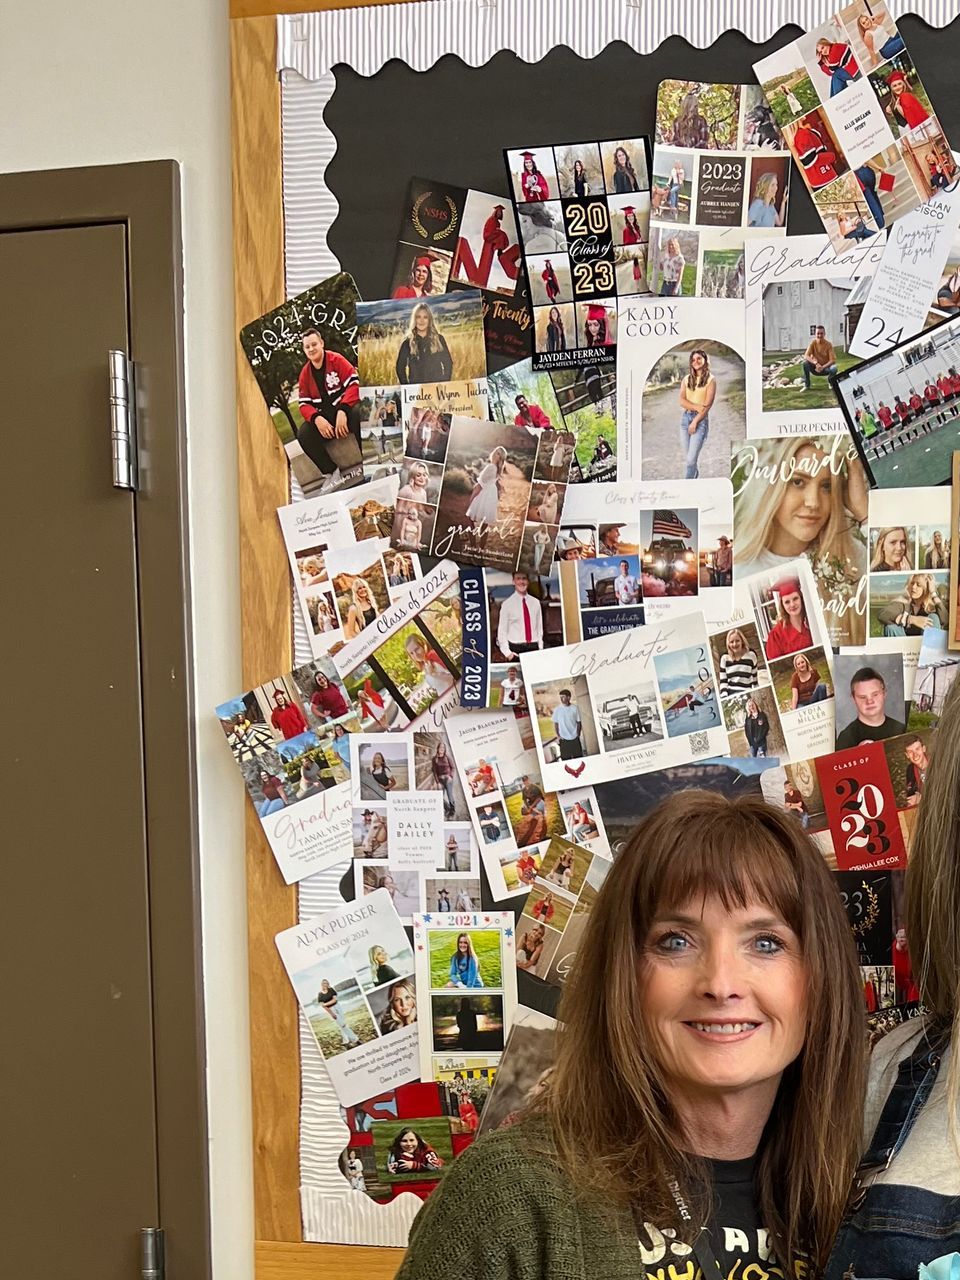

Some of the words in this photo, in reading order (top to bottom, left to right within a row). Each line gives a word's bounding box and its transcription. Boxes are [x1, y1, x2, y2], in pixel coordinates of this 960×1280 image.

[702, 163, 742, 180] 2023
[701, 181, 742, 194] Graduate
[424, 207, 448, 220] NSHS
[566, 202, 609, 236] 20
[923, 200, 951, 214] LIAN
[568, 236, 599, 263] Class
[747, 234, 887, 287] Graduate
[573, 260, 614, 294] 23
[492, 300, 530, 331] Twenty
[627, 305, 678, 322] KADY
[254, 304, 302, 362] 2024
[626, 322, 680, 337] COOK
[864, 316, 905, 347] 24
[539, 352, 571, 363] JAYDEN
[572, 348, 606, 359] FERRAN
[404, 388, 432, 403] Loralee
[436, 385, 460, 402] Wynn
[777, 423, 808, 434] TYLER
[731, 434, 844, 498] Onward
[435, 512, 521, 557] graduate
[376, 607, 408, 634] Class
[408, 590, 421, 610] of
[418, 570, 449, 600] 2024
[462, 578, 482, 633] CLASS
[587, 627, 599, 635] THE
[464, 638, 485, 660] of
[569, 629, 674, 686] Graduate
[464, 665, 482, 701] 2023
[798, 711, 826, 724] MILLER
[799, 706, 822, 718] LYDIA
[458, 726, 477, 737] JACOB
[478, 717, 508, 733] BLACKHAM
[833, 761, 858, 771] CLASS
[859, 757, 870, 765] OF
[835, 778, 884, 820] 20
[274, 792, 352, 849] Gradua
[840, 813, 890, 855] 23
[298, 824, 340, 848] TANALYN
[874, 859, 886, 867] LEE
[886, 856, 899, 865] COX
[296, 924, 328, 948] ALYX
[328, 904, 377, 935] PURSER
[316, 940, 339, 956] CLASS
[339, 937, 350, 947] OF
[350, 928, 370, 943] 2024
[667, 1180, 692, 1221] District
[721, 1227, 750, 1253] A
